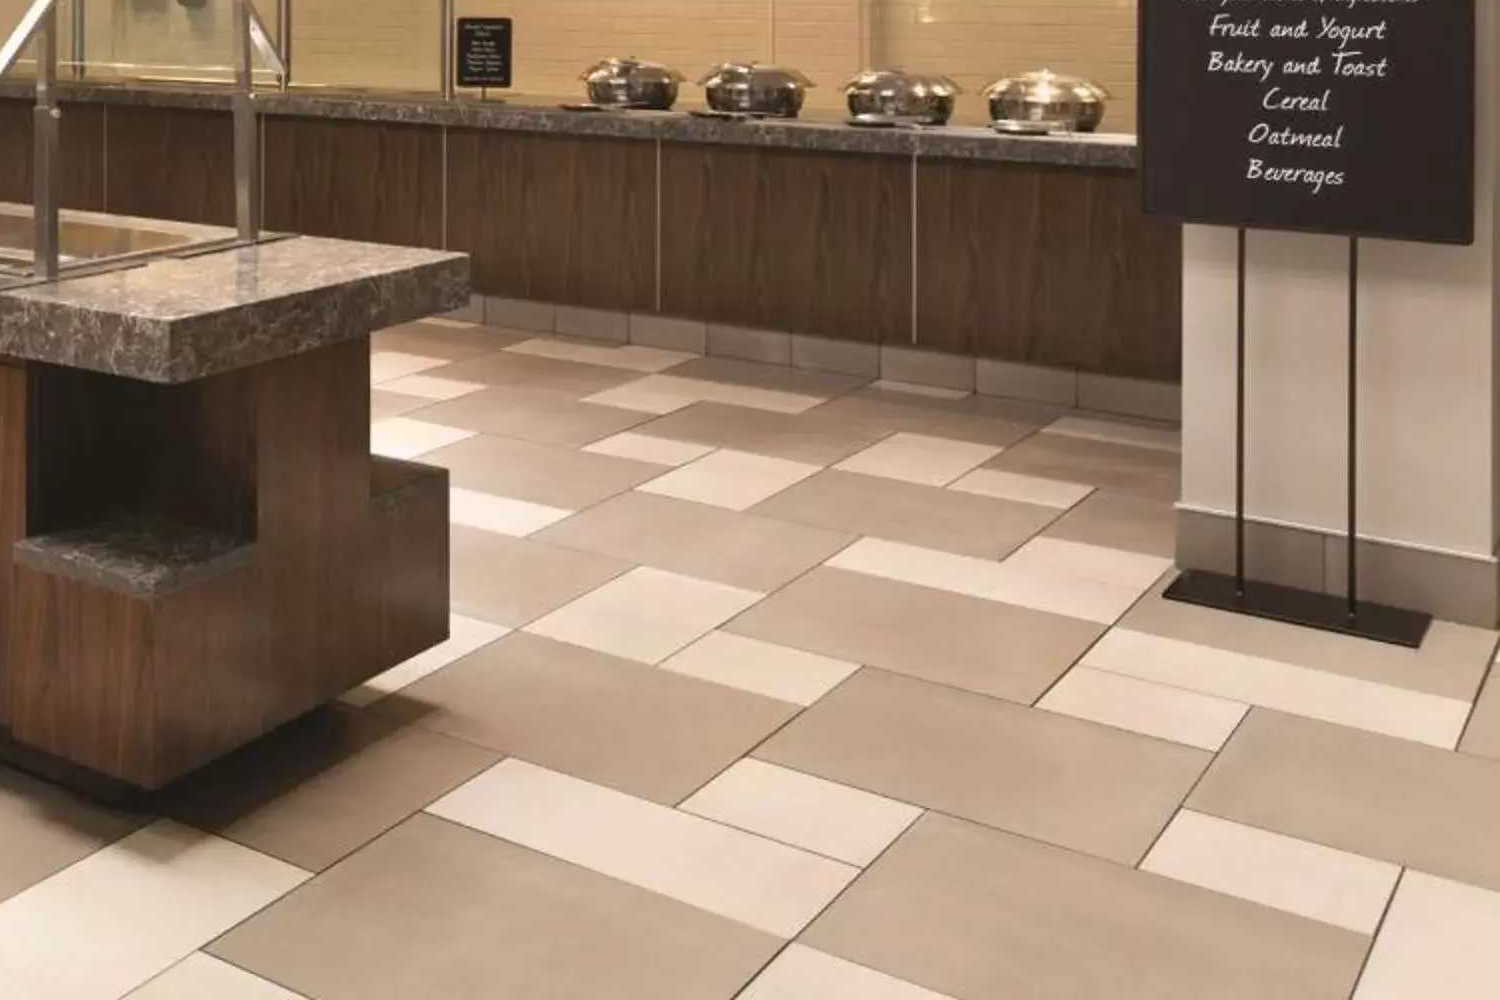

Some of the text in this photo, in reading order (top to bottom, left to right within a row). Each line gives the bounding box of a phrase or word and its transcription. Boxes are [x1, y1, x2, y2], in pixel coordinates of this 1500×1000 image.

[1209, 13, 1387, 50] Fruit and Yogurt
[1207, 50, 1388, 83] Bakery and Toast
[1262, 86, 1332, 111] Cereal
[1248, 122, 1344, 148] Oatmeal
[1246, 158, 1345, 194] Beverages
